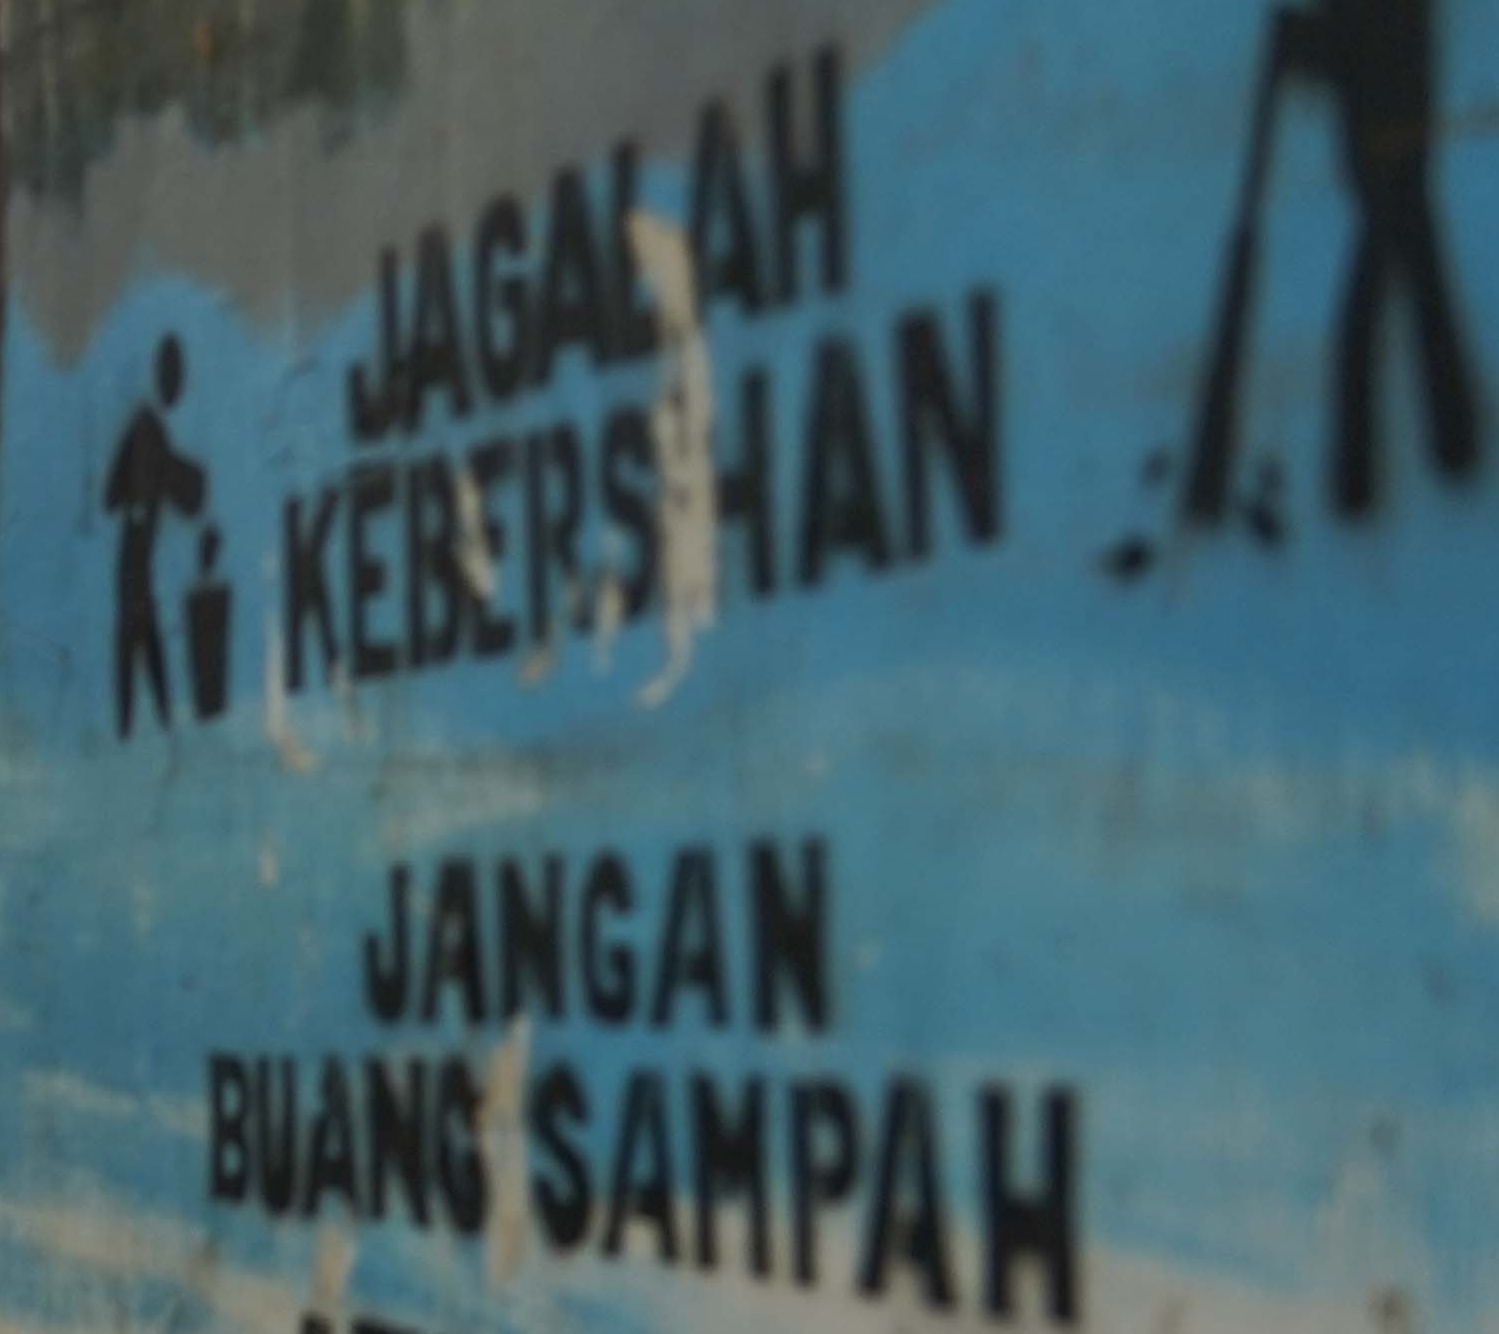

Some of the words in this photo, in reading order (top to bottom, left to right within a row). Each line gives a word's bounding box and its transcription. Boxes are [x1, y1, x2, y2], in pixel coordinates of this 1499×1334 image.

[347, 49, 847, 447] JAGALAH
[282, 289, 1006, 693] KEBERSHAN
[364, 834, 834, 1041] JANGAN
[208, 1052, 490, 1242] BUANG
[531, 1065, 1082, 1334] SAMPAH
